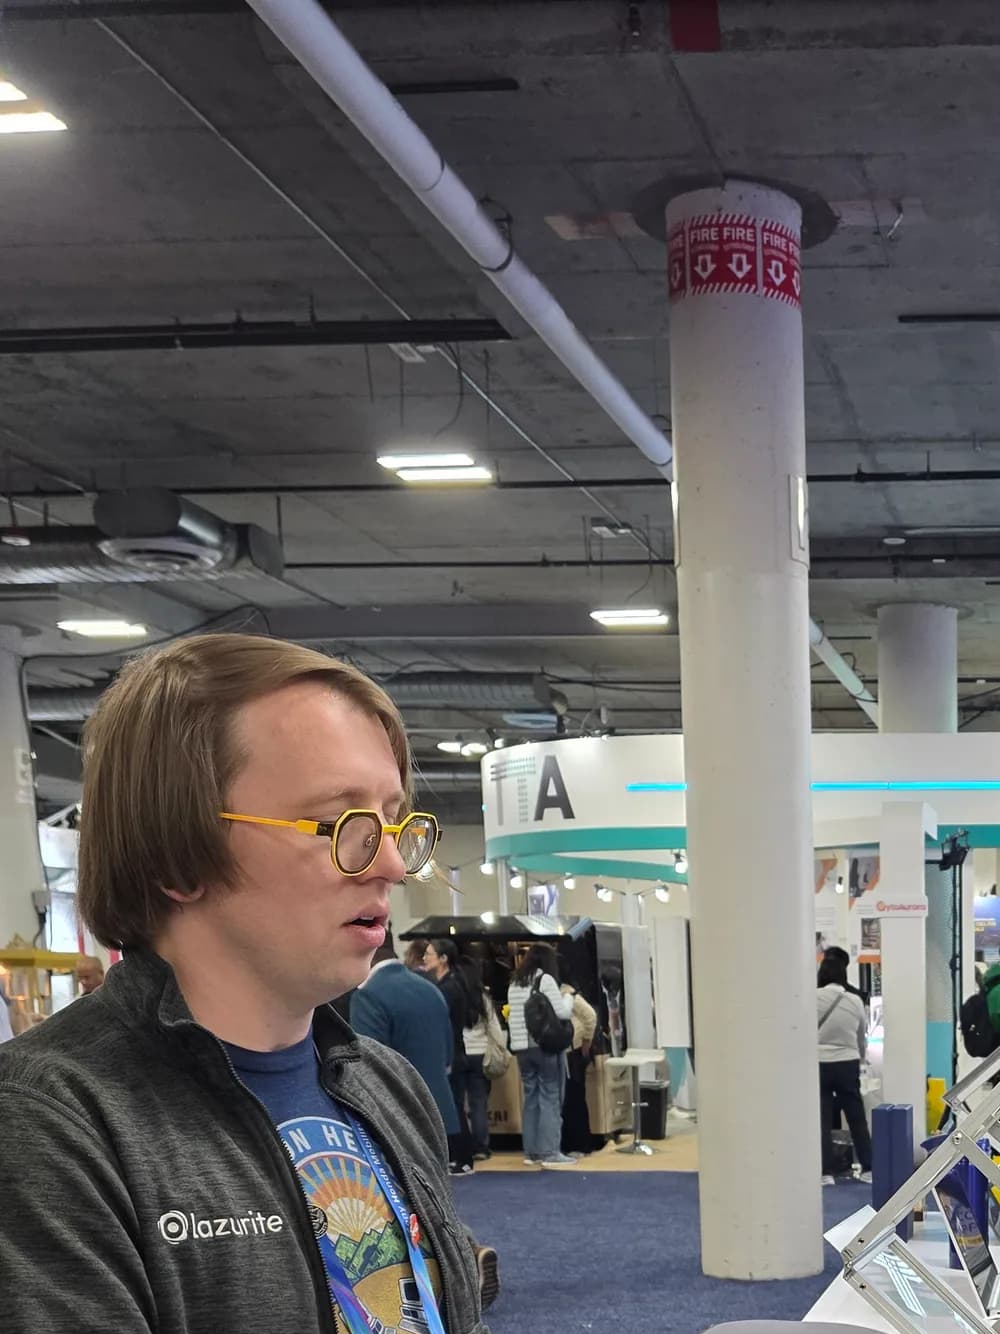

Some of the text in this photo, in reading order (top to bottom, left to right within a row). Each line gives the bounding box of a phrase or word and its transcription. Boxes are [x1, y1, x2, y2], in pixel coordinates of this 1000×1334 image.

[690, 227, 755, 243] FIRE FIRE
[763, 232, 787, 251] FIRE
[283, 1128, 312, 1160] N
[190, 1210, 283, 1239] lazurite
